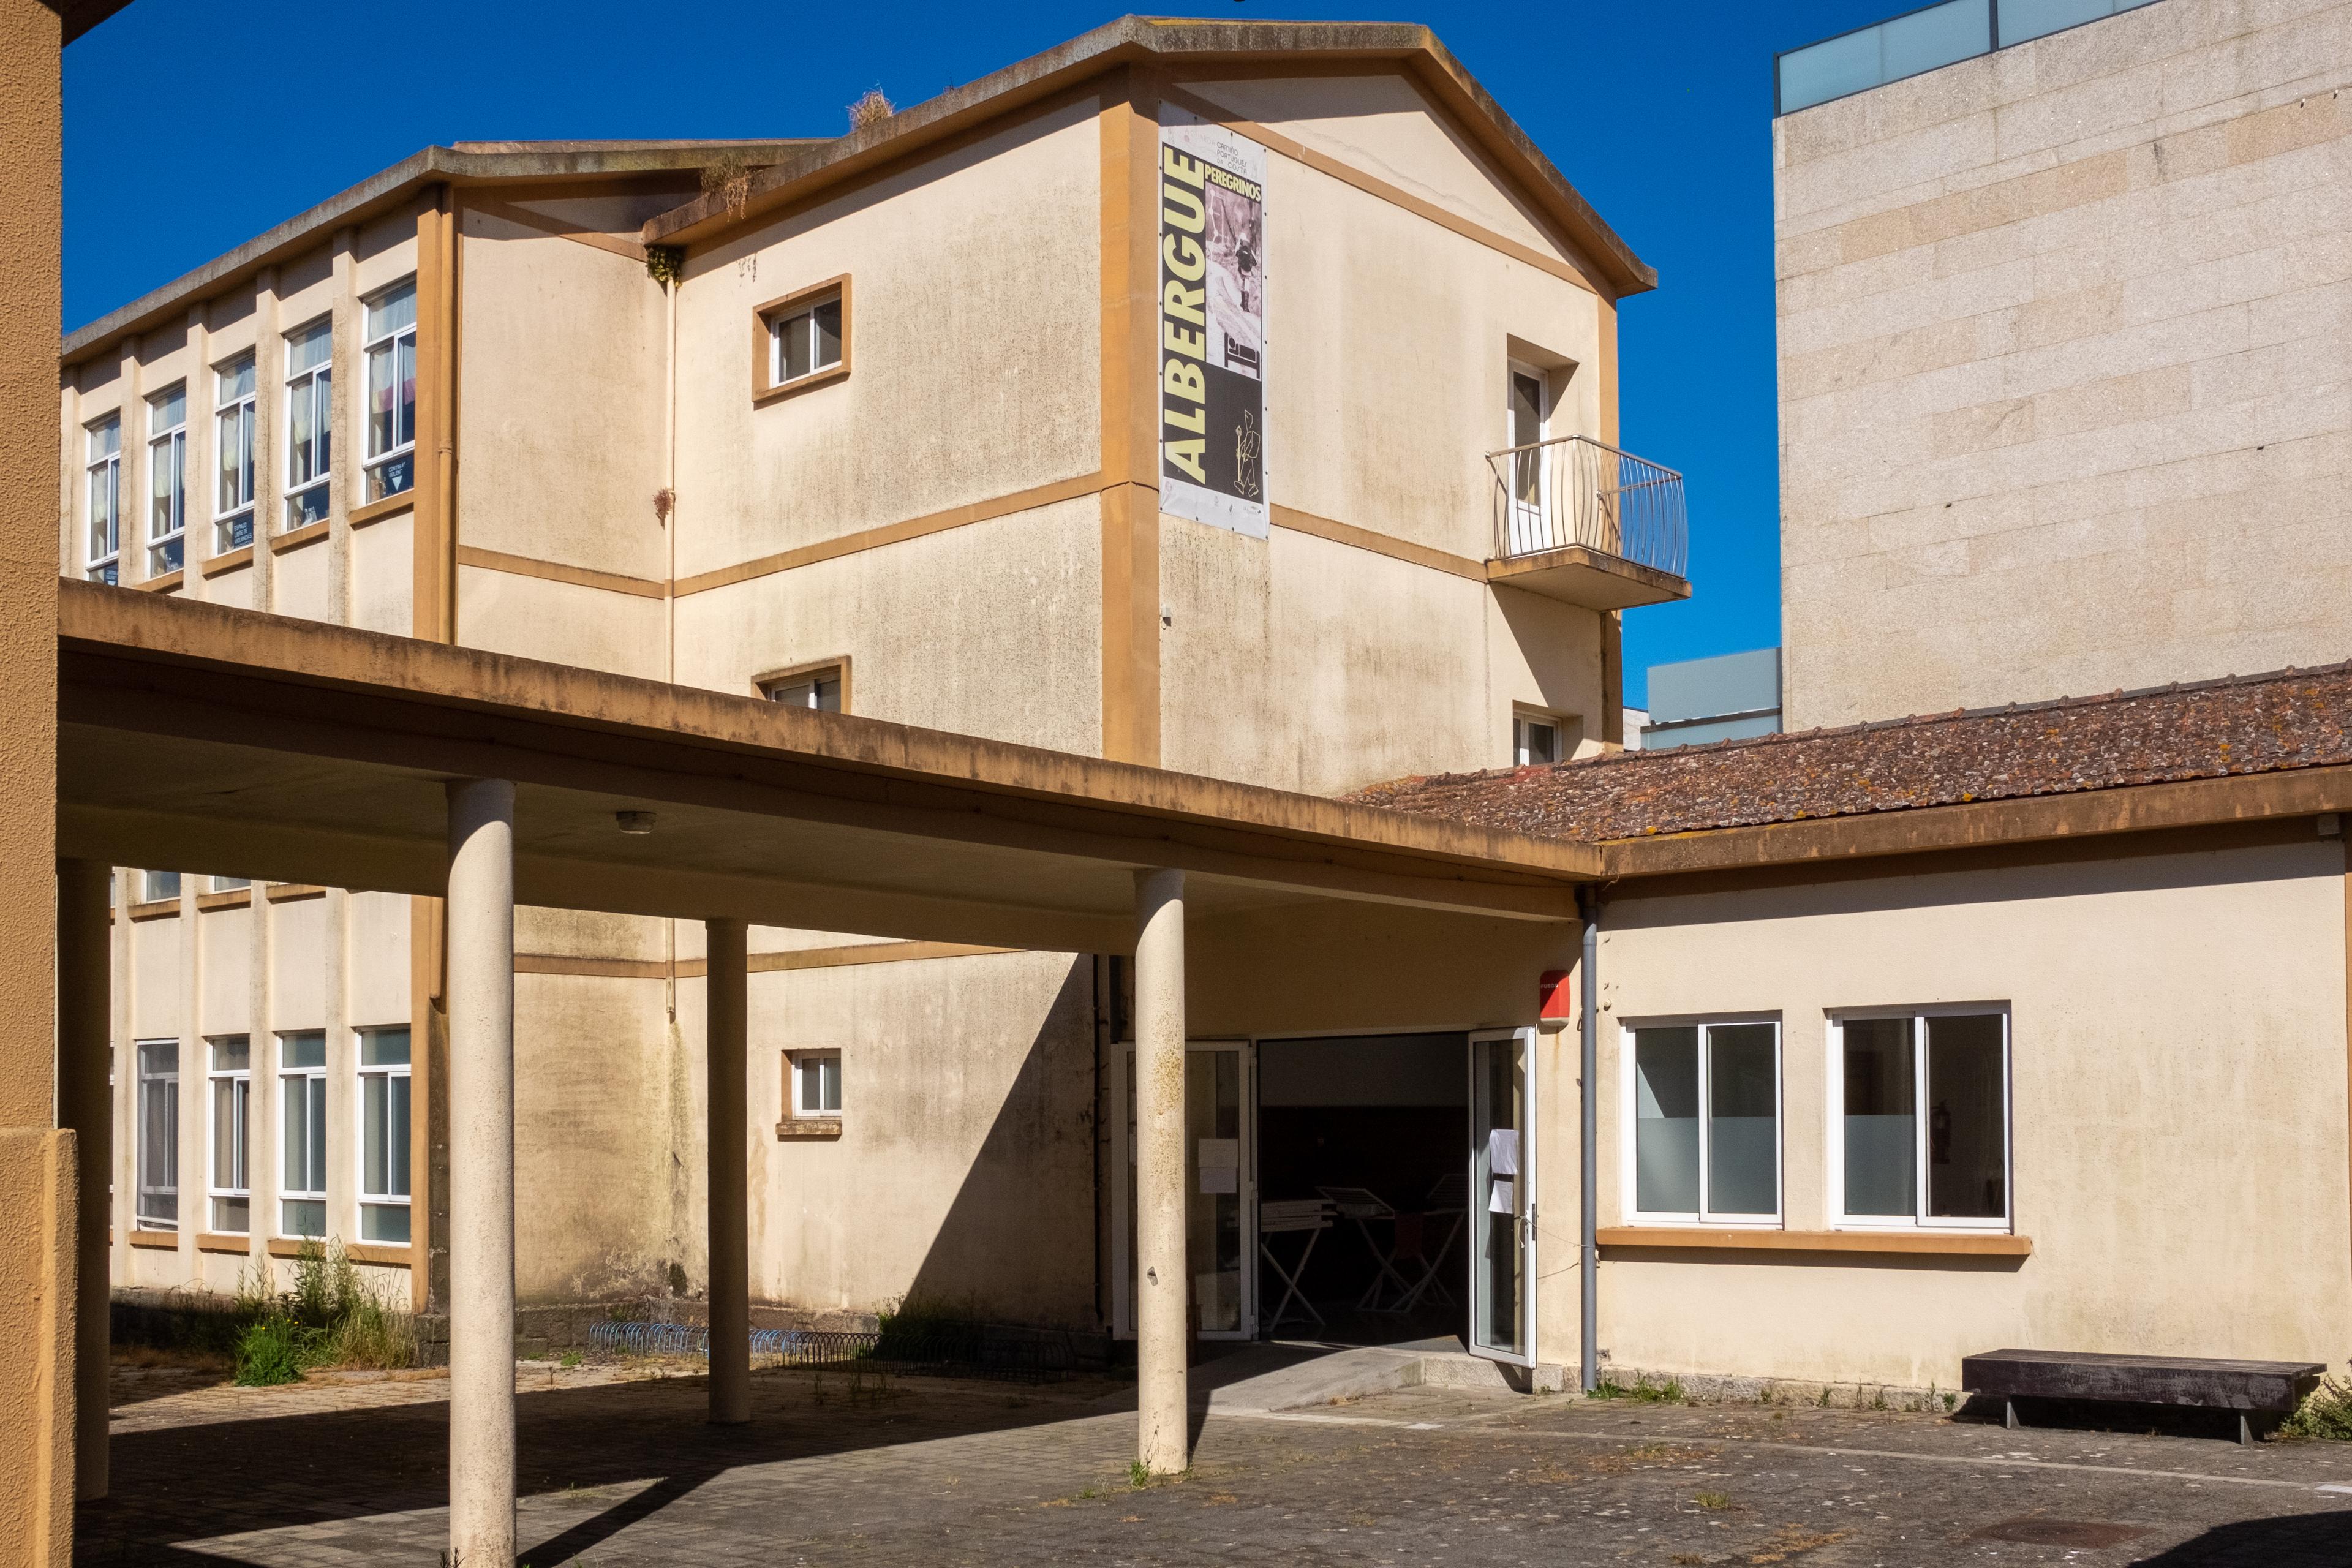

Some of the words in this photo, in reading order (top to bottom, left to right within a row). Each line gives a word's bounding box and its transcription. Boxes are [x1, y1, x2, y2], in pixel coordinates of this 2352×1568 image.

[1216, 141, 1238, 156] CAMIÑO
[1227, 162, 1248, 175] COSTA
[1205, 164, 1261, 202] PEREGRINOS
[1163, 146, 1205, 485] ALBERGUE
